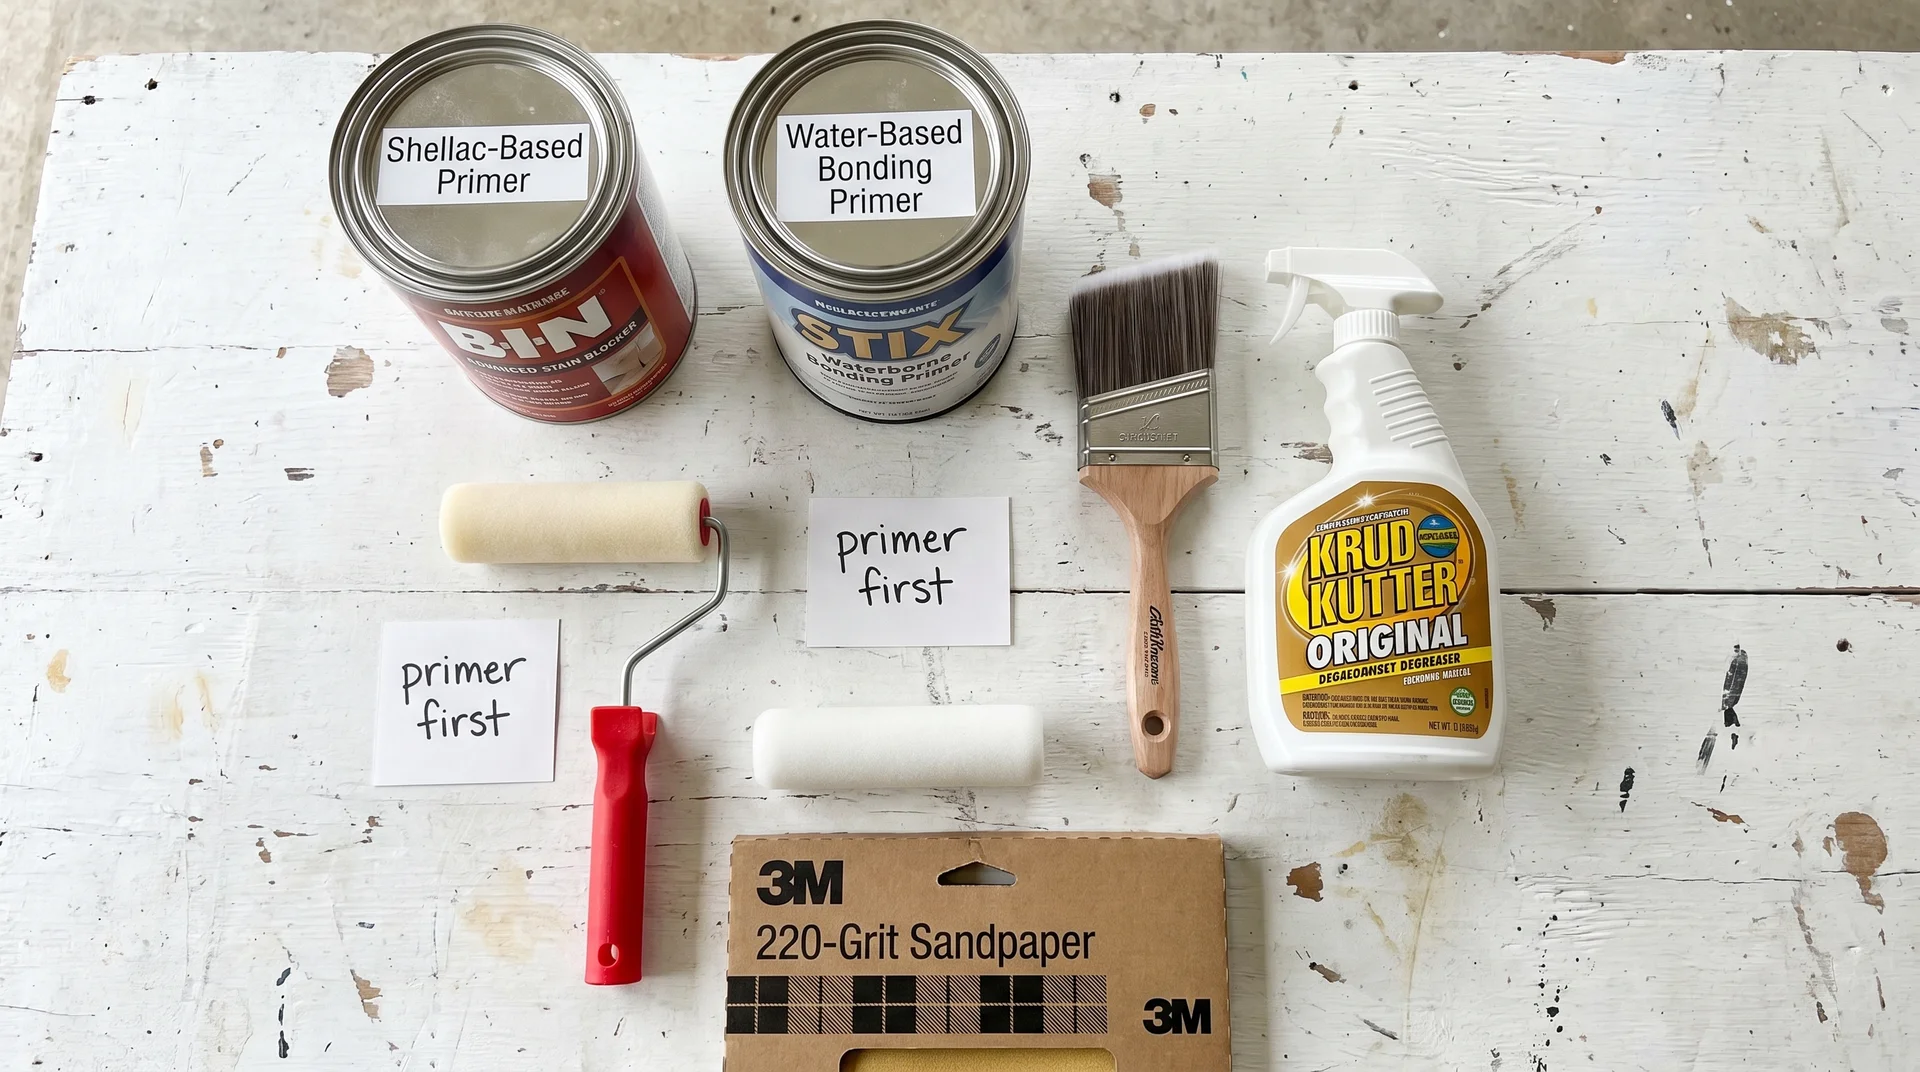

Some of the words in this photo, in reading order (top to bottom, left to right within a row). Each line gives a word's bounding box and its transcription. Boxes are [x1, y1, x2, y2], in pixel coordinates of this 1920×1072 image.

[387, 133, 583, 163] Shellac-Based
[786, 118, 962, 149] Water-Based
[437, 168, 530, 195] Primer
[818, 154, 932, 184] Bonding
[830, 188, 923, 214] Primer
[542, 358, 581, 372] STAIN
[584, 320, 638, 360] BLOCKER
[797, 306, 965, 360] STIX
[806, 352, 894, 386] Bonding
[901, 351, 971, 384] Primer
[821, 352, 952, 374] Waterborne
[837, 524, 967, 574] primer
[1308, 519, 1415, 580] KRUD
[858, 566, 953, 606] first
[1308, 561, 1459, 629] KUTTER
[1306, 613, 1468, 670] ORIGINAL
[402, 656, 526, 705] primer
[1400, 653, 1461, 672] DEGREASER
[417, 698, 510, 740] first
[1428, 721, 1440, 730] NET
[756, 860, 843, 905] 3M
[756, 923, 899, 961] 220-Grit
[910, 922, 1096, 968] Sandpaper
[1142, 998, 1211, 1035] 3M
